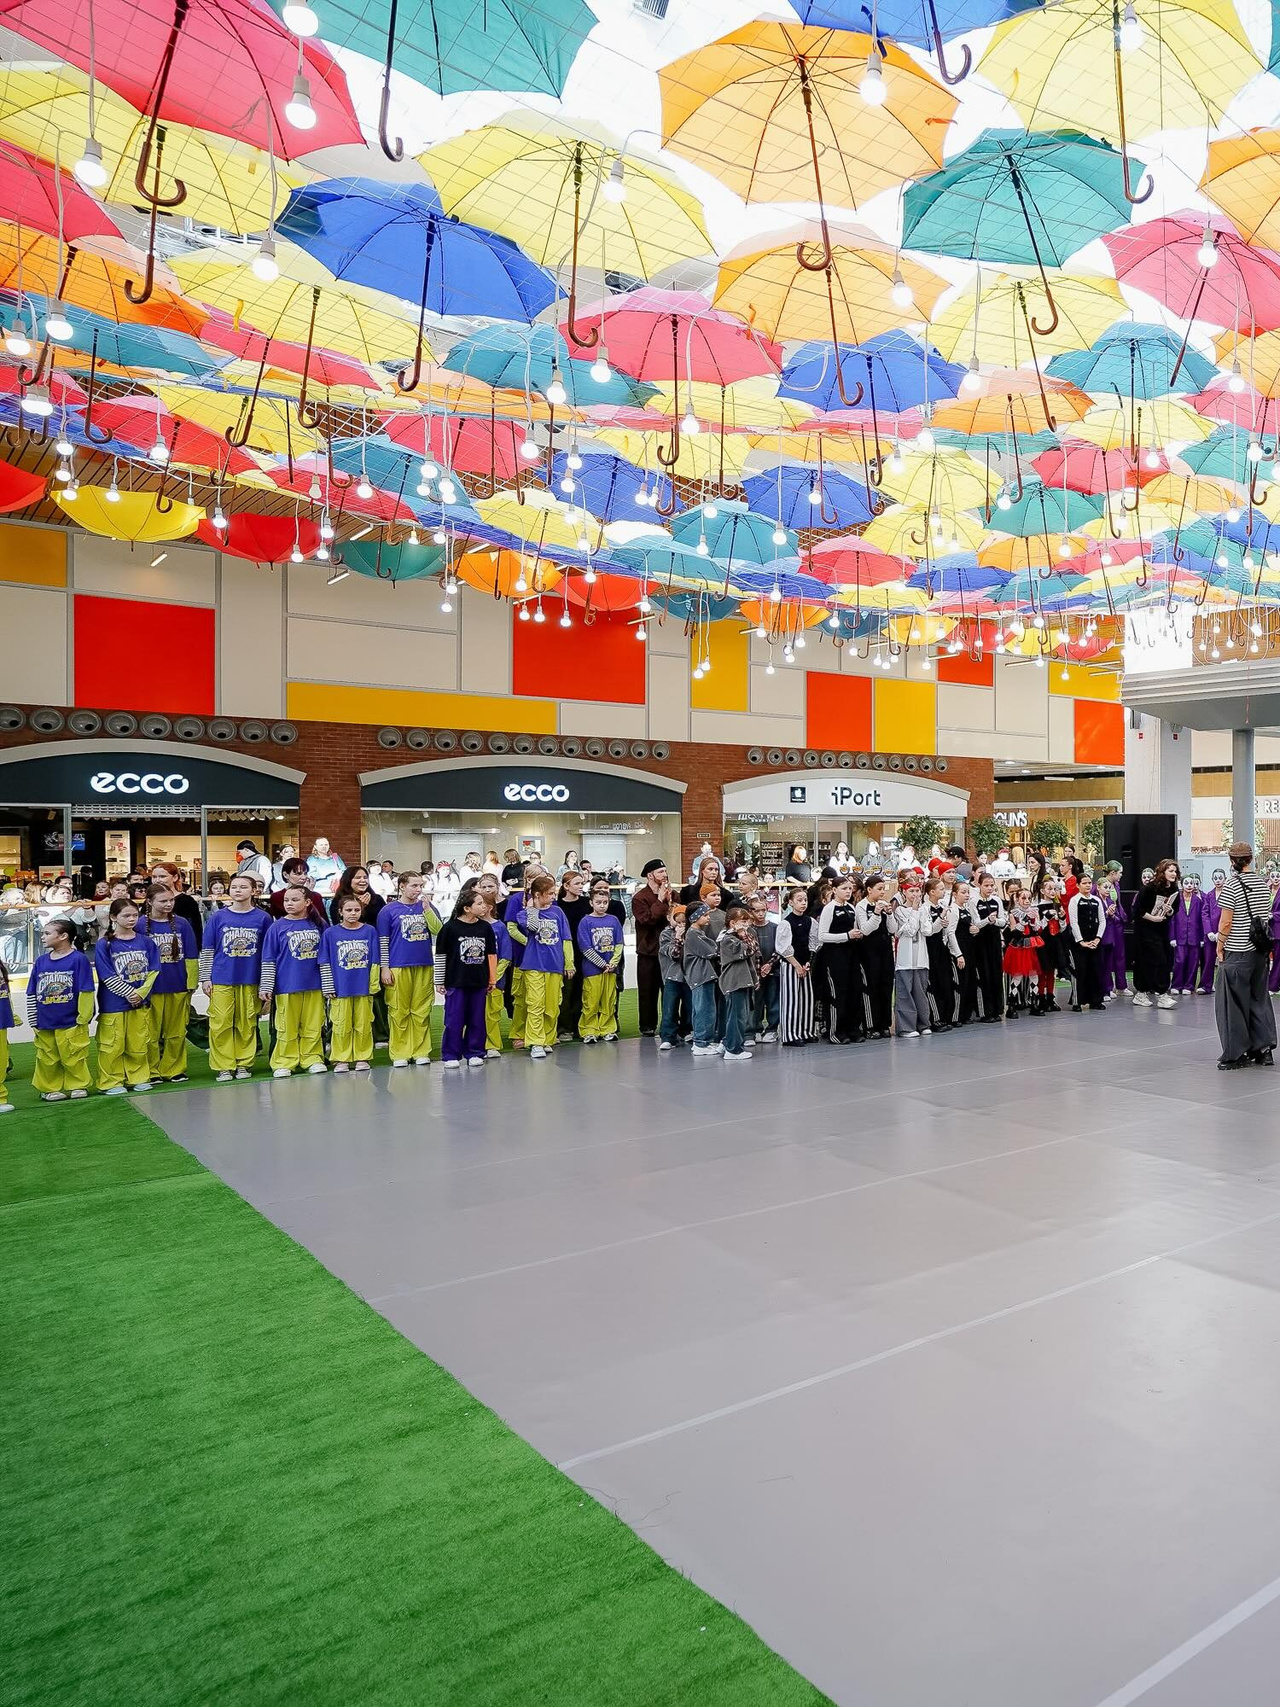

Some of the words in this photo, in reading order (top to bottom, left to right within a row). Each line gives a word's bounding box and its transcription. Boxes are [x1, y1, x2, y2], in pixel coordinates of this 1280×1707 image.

[90, 772, 190, 794] ecco
[504, 783, 570, 802] ecco
[831, 786, 881, 806] iPort
[993, 809, 1028, 827] OLIN'S
